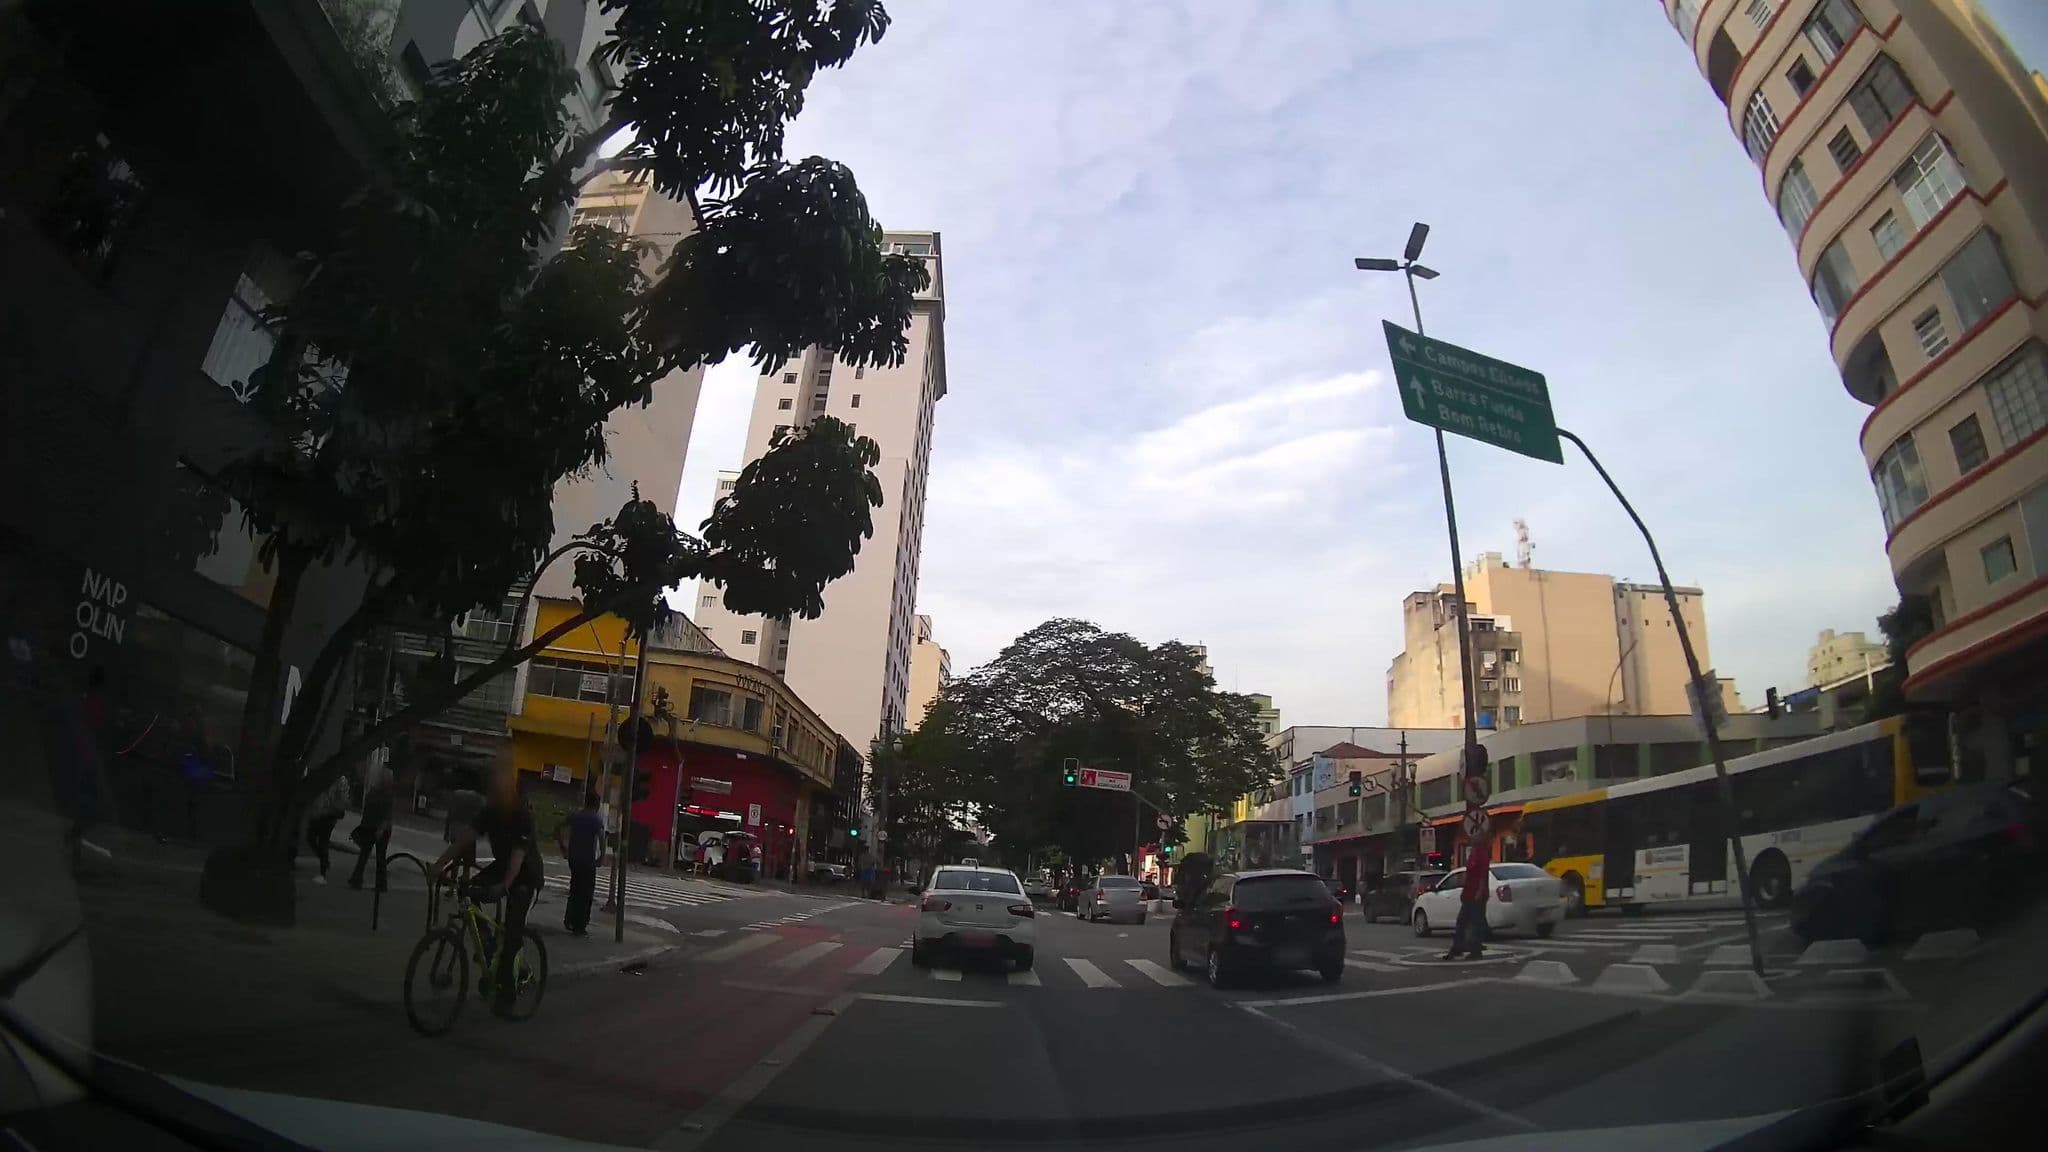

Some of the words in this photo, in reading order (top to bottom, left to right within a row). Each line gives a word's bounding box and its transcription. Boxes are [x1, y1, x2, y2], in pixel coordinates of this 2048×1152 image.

[1425, 346, 1487, 378] Campos
[1432, 380, 1479, 406] Barra
[1480, 393, 1525, 423] Funda
[1438, 405, 1475, 427] Bom
[1478, 416, 1522, 442] Retiro
[82, 568, 128, 607] NAP
[77, 601, 126, 644] OLIN
[70, 631, 88, 659] O
